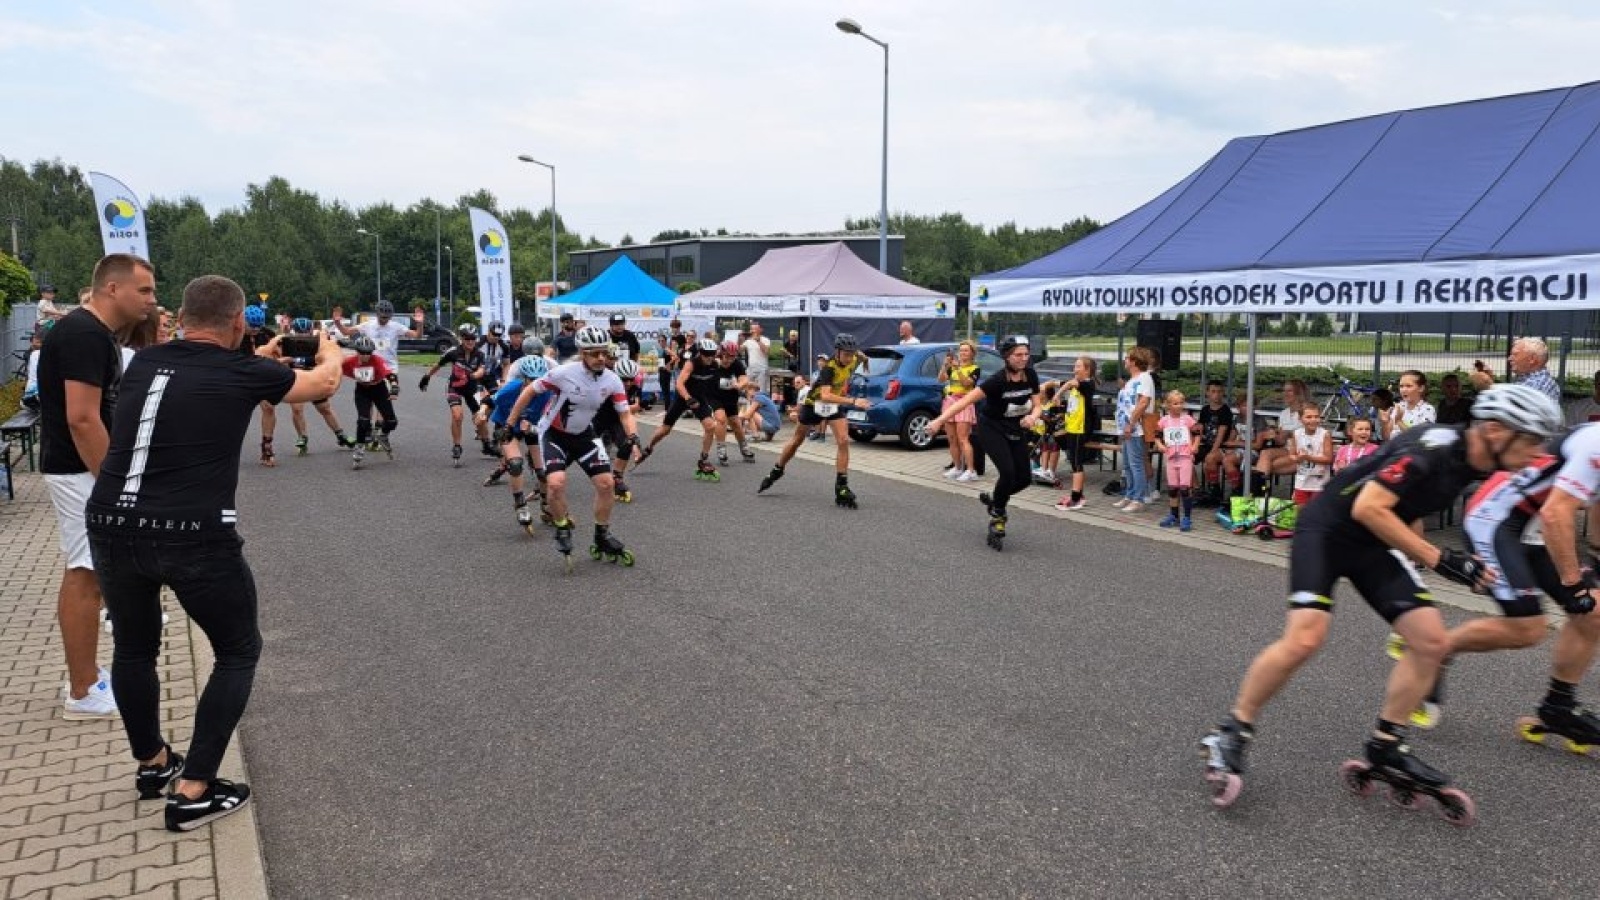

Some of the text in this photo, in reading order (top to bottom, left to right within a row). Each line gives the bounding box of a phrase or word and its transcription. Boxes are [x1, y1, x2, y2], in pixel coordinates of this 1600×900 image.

[1042, 272, 1588, 307] RYDUŁTOWSKI OŚRODEK SPORTU I REKREACJI
[138, 517, 201, 531] PLEIN
